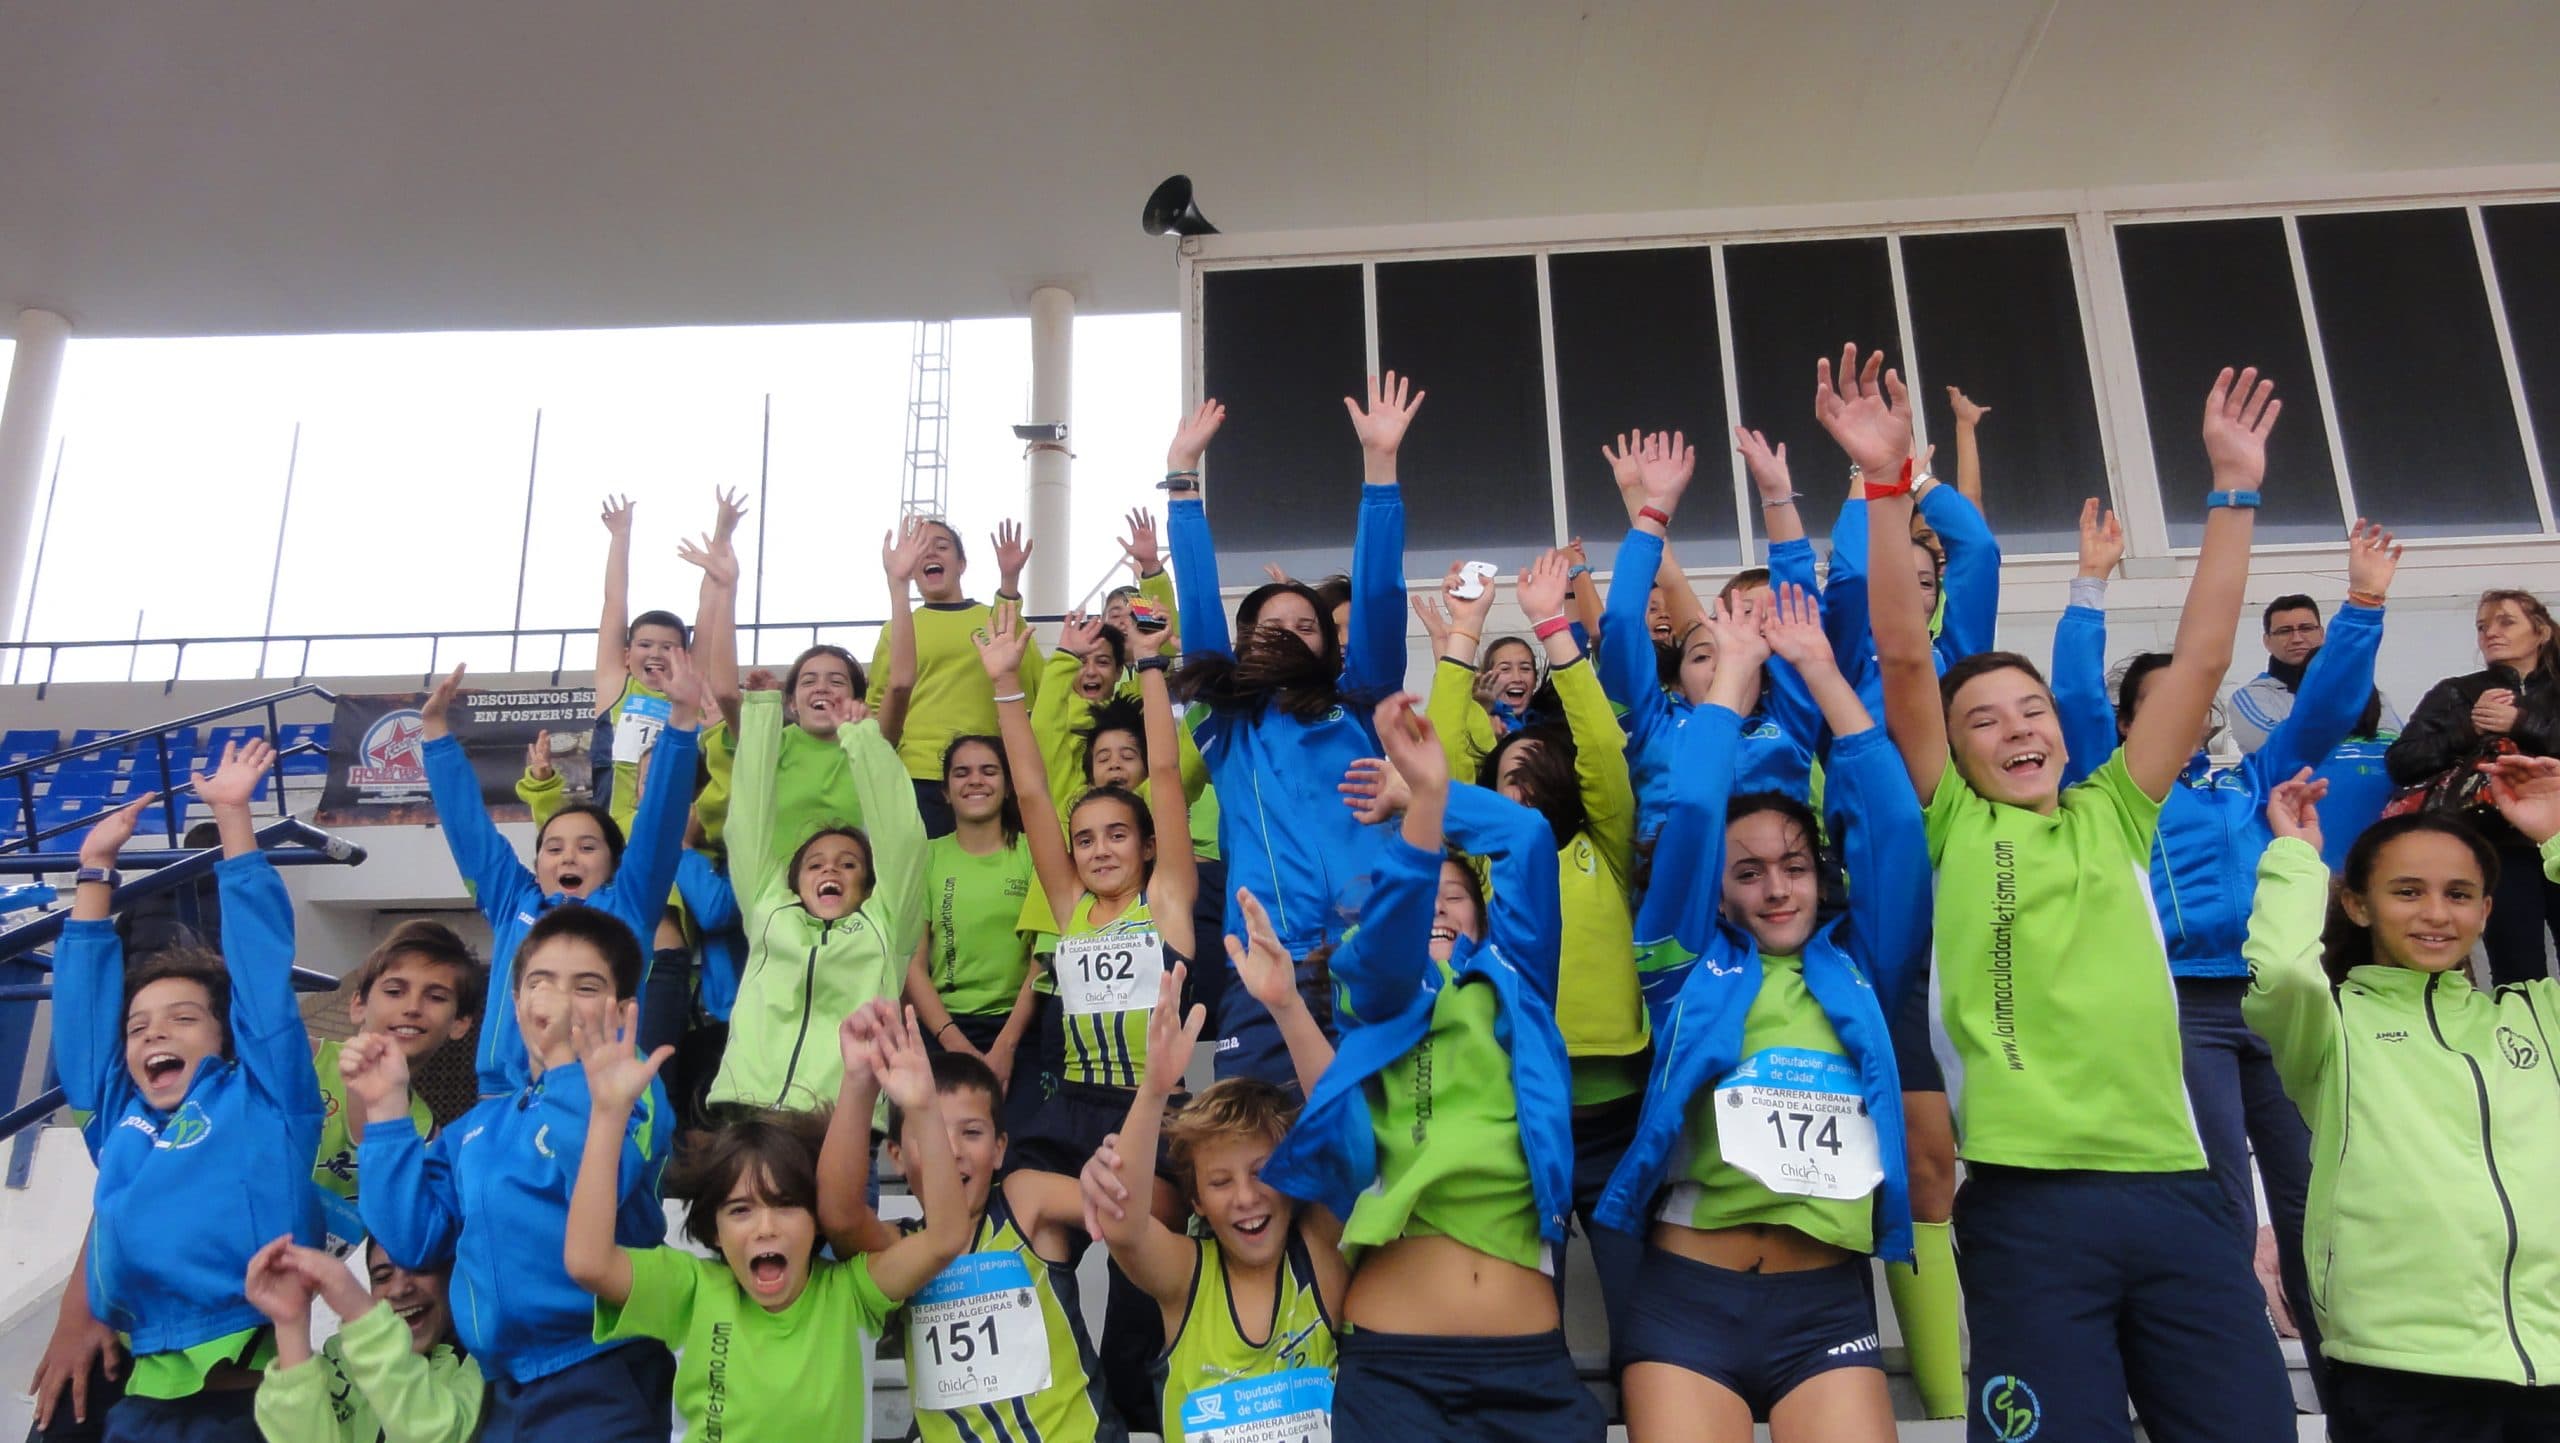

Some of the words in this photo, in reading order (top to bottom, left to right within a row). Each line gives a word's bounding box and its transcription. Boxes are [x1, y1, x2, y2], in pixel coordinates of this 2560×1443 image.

[467, 692, 569, 706] DESCUENTOS
[474, 711, 499, 723] EN
[500, 708, 573, 722] FOSTER'S
[1104, 942, 1142, 950] ALGECIRAS
[1986, 840, 2026, 1071] www.lainmaculadaatletismo.com
[1078, 951, 1134, 982] 162
[1769, 1054, 1824, 1069] Diputación
[1770, 1069, 1783, 1080] de
[1753, 1087, 1764, 1096] XV
[1766, 1088, 1812, 1100] CARRERA
[1815, 1092, 1851, 1103] URBANA
[1752, 1097, 1784, 1109] CIUDAD
[1786, 1100, 1799, 1110] DE
[1802, 1103, 1852, 1114] ALGECIRAS
[1766, 1110, 1843, 1156] 174
[936, 1281, 965, 1294] Cádiz
[923, 1300, 967, 1313] CARRERA
[968, 1291, 1009, 1305] URBANA
[943, 1313, 956, 1322] DE
[958, 1301, 1013, 1319] ALGECIRAS
[926, 1315, 999, 1366] 151
[1234, 1382, 1289, 1402] Diputación
[1238, 1405, 1251, 1416] de
[1254, 1399, 1283, 1413] Cádiz
[1224, 1427, 1236, 1436] XV
[1238, 1419, 1285, 1434] CARRERA
[1286, 1411, 1316, 1424] URBANA
[1262, 1431, 1273, 1440] DE
[1277, 1422, 1319, 1439] ALGECIRAS
